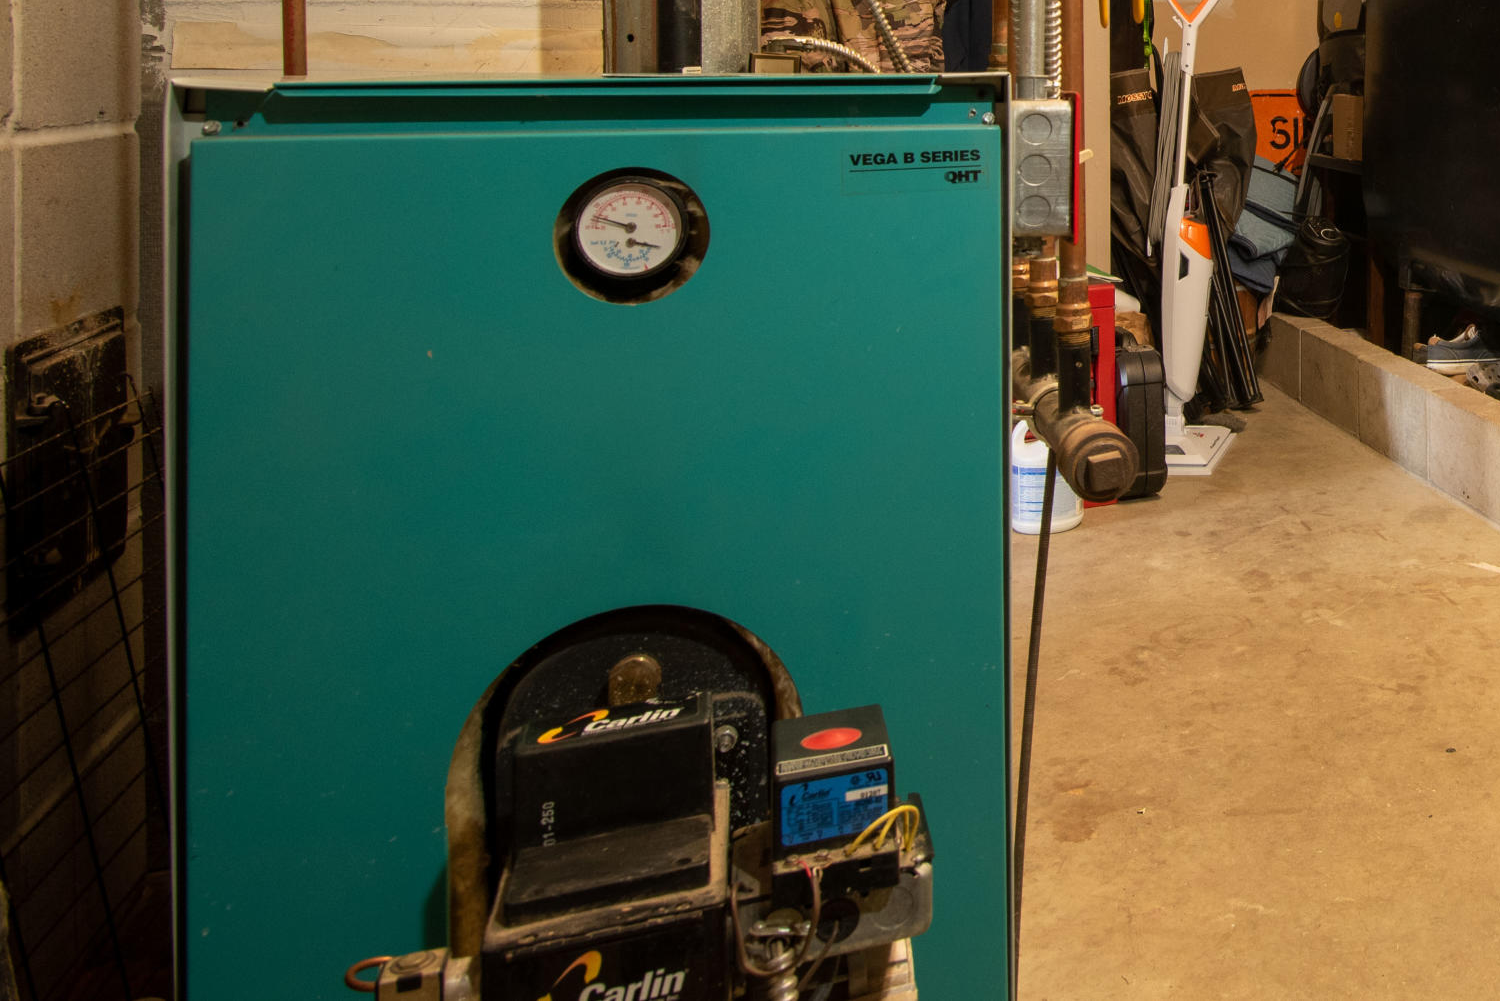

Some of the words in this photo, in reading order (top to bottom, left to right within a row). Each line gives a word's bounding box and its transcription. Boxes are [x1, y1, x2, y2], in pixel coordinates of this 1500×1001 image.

[1117, 91, 1147, 105] MOSSY
[849, 153, 898, 166] VEGA
[903, 152, 915, 164] B
[920, 150, 981, 163] SERIES
[944, 170, 981, 183] QHT
[581, 707, 684, 736] Carlin
[578, 967, 687, 1001] Carlin
